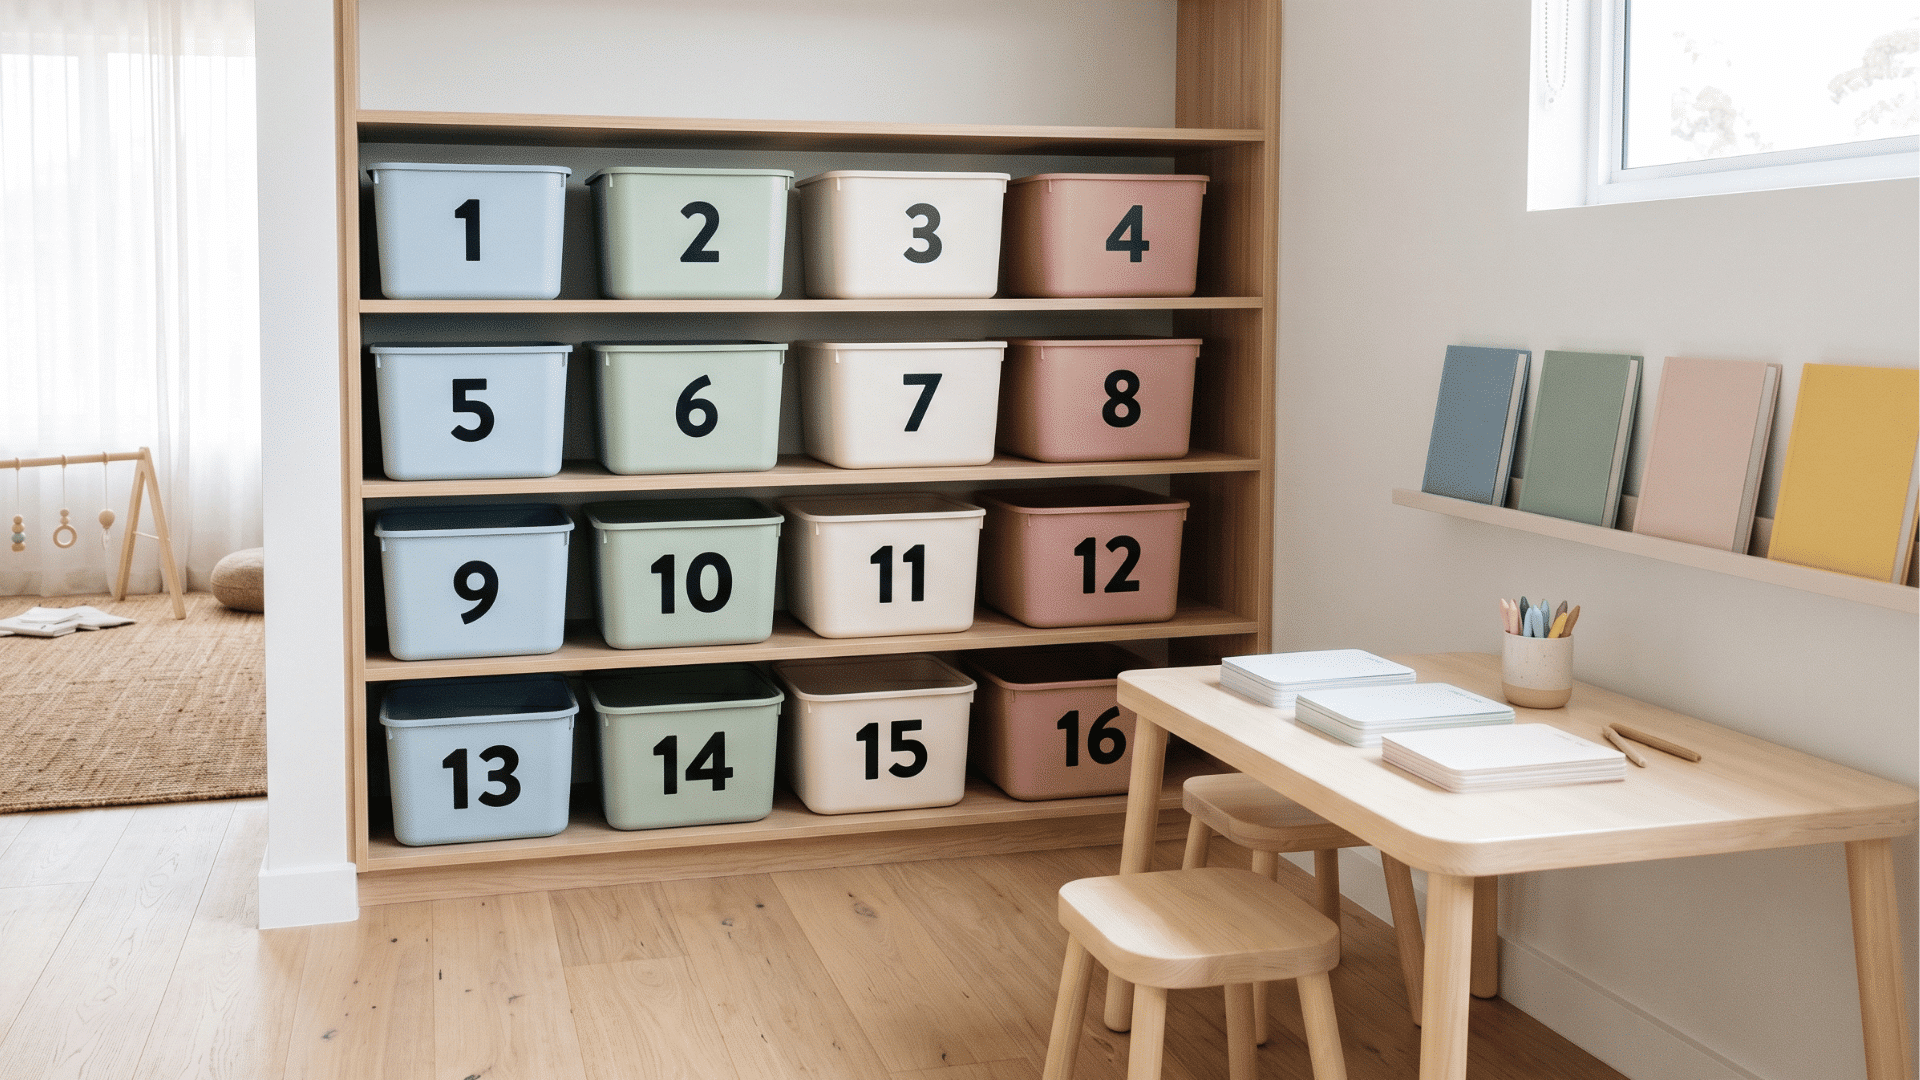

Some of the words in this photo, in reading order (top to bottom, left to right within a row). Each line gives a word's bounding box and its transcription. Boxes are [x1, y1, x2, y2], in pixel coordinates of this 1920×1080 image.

[455, 199, 480, 261] 1
[680, 201, 719, 262] 2
[904, 203, 942, 263] 3
[1106, 205, 1149, 262] 4
[451, 379, 494, 442] 5
[676, 375, 718, 437] 6
[903, 374, 942, 431] 7
[1102, 370, 1141, 428] 8
[454, 561, 498, 624] 9
[651, 552, 732, 614] 10
[871, 545, 924, 603] 11
[1074, 535, 1141, 594] 12
[653, 732, 733, 795] 14
[856, 719, 927, 780] 15
[1057, 706, 1126, 767] 16
[443, 745, 521, 809] 13
